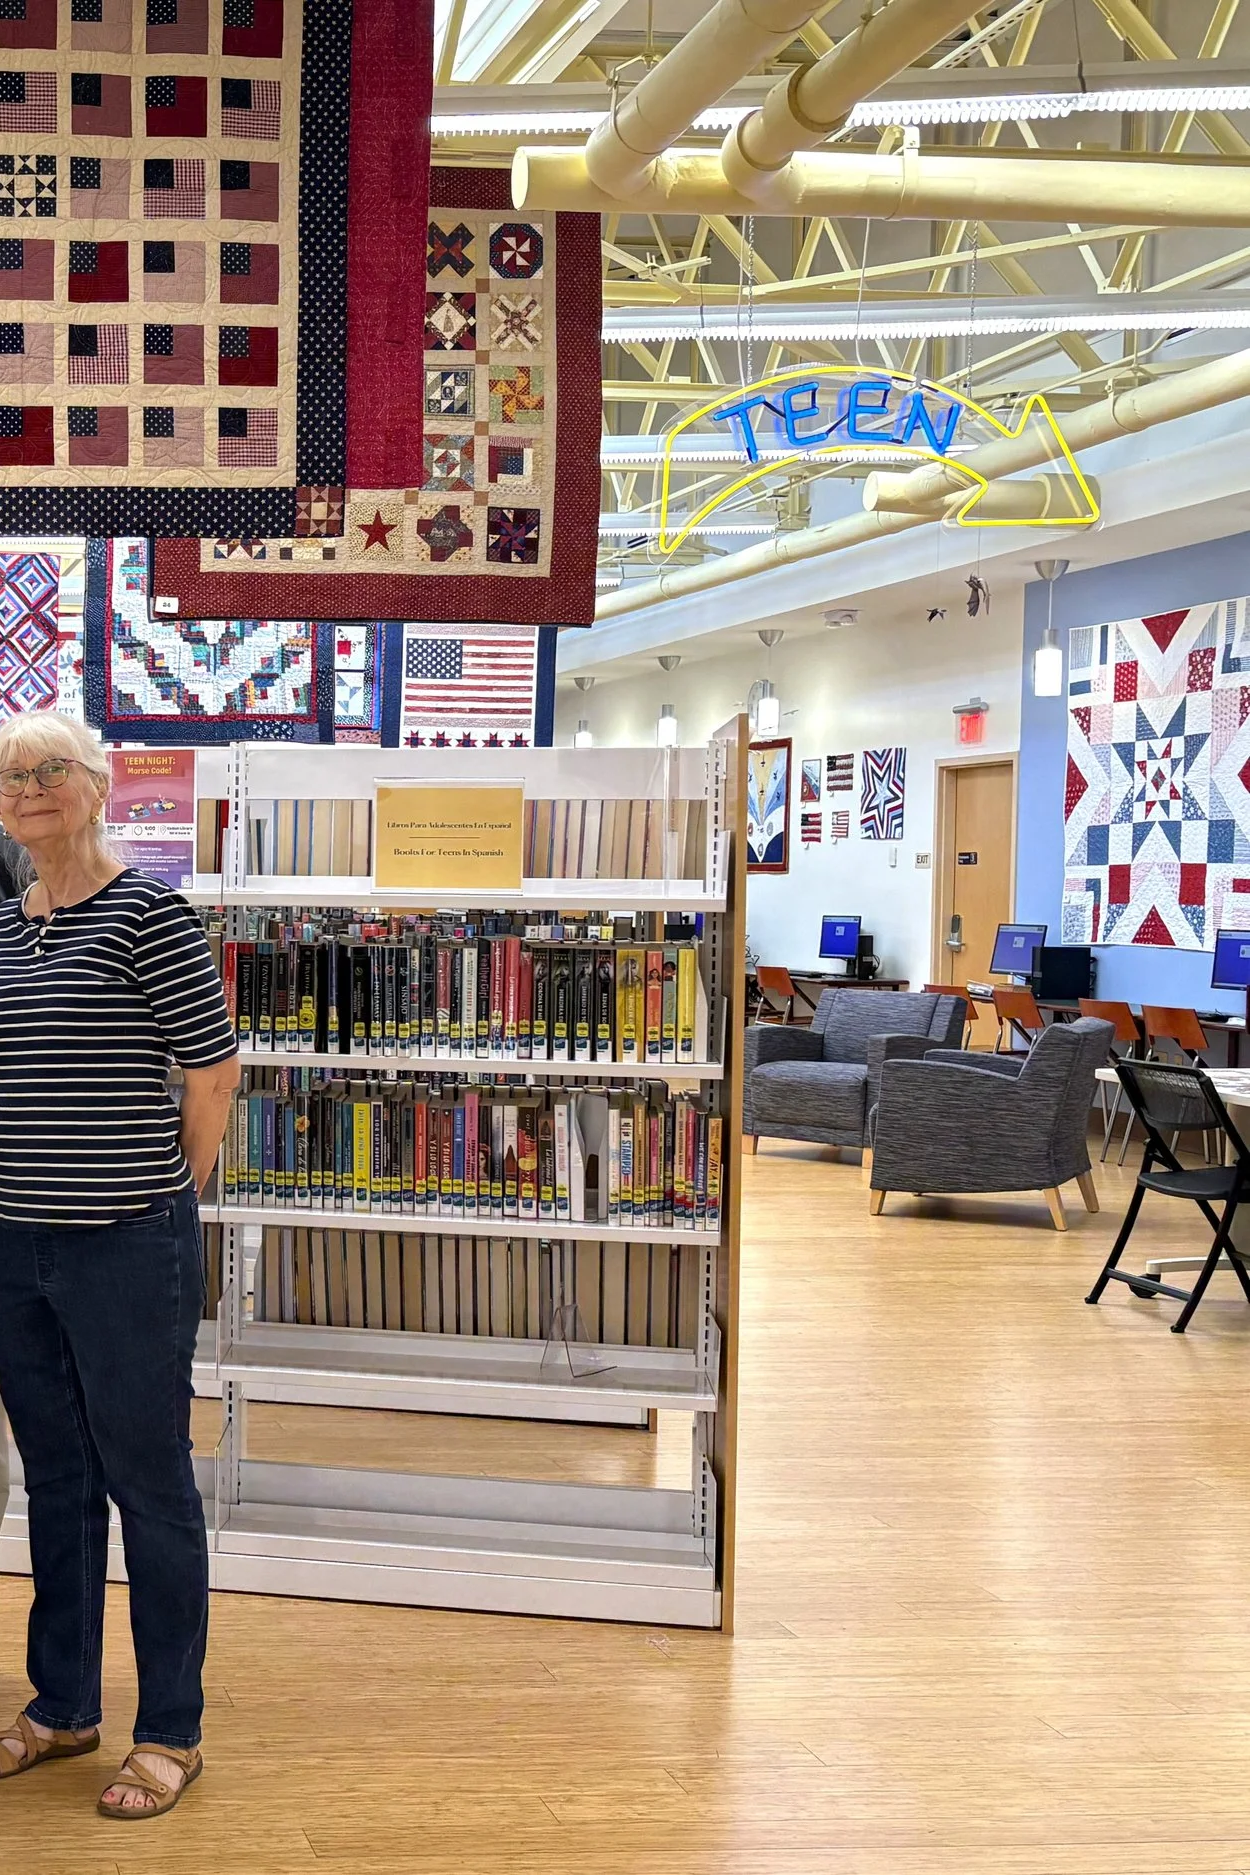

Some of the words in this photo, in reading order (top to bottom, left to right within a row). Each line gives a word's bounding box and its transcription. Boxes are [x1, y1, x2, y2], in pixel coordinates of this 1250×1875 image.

[713, 381, 961, 463] TEEN
[64, 691, 76, 699] of
[124, 757, 147, 765] TEEN
[148, 757, 176, 765] NIGHT:
[127, 767, 150, 775] Morse
[151, 767, 172, 775] Code!
[394, 848, 420, 856] Books
[421, 848, 436, 856] For
[438, 848, 461, 856] Teens
[462, 848, 471, 856] In
[472, 848, 504, 857] Spanish
[917, 854, 929, 864] EXIT
[479, 954, 490, 985] Feather
[479, 985, 490, 999] Girl
[622, 1140, 631, 1175] STAMPED
